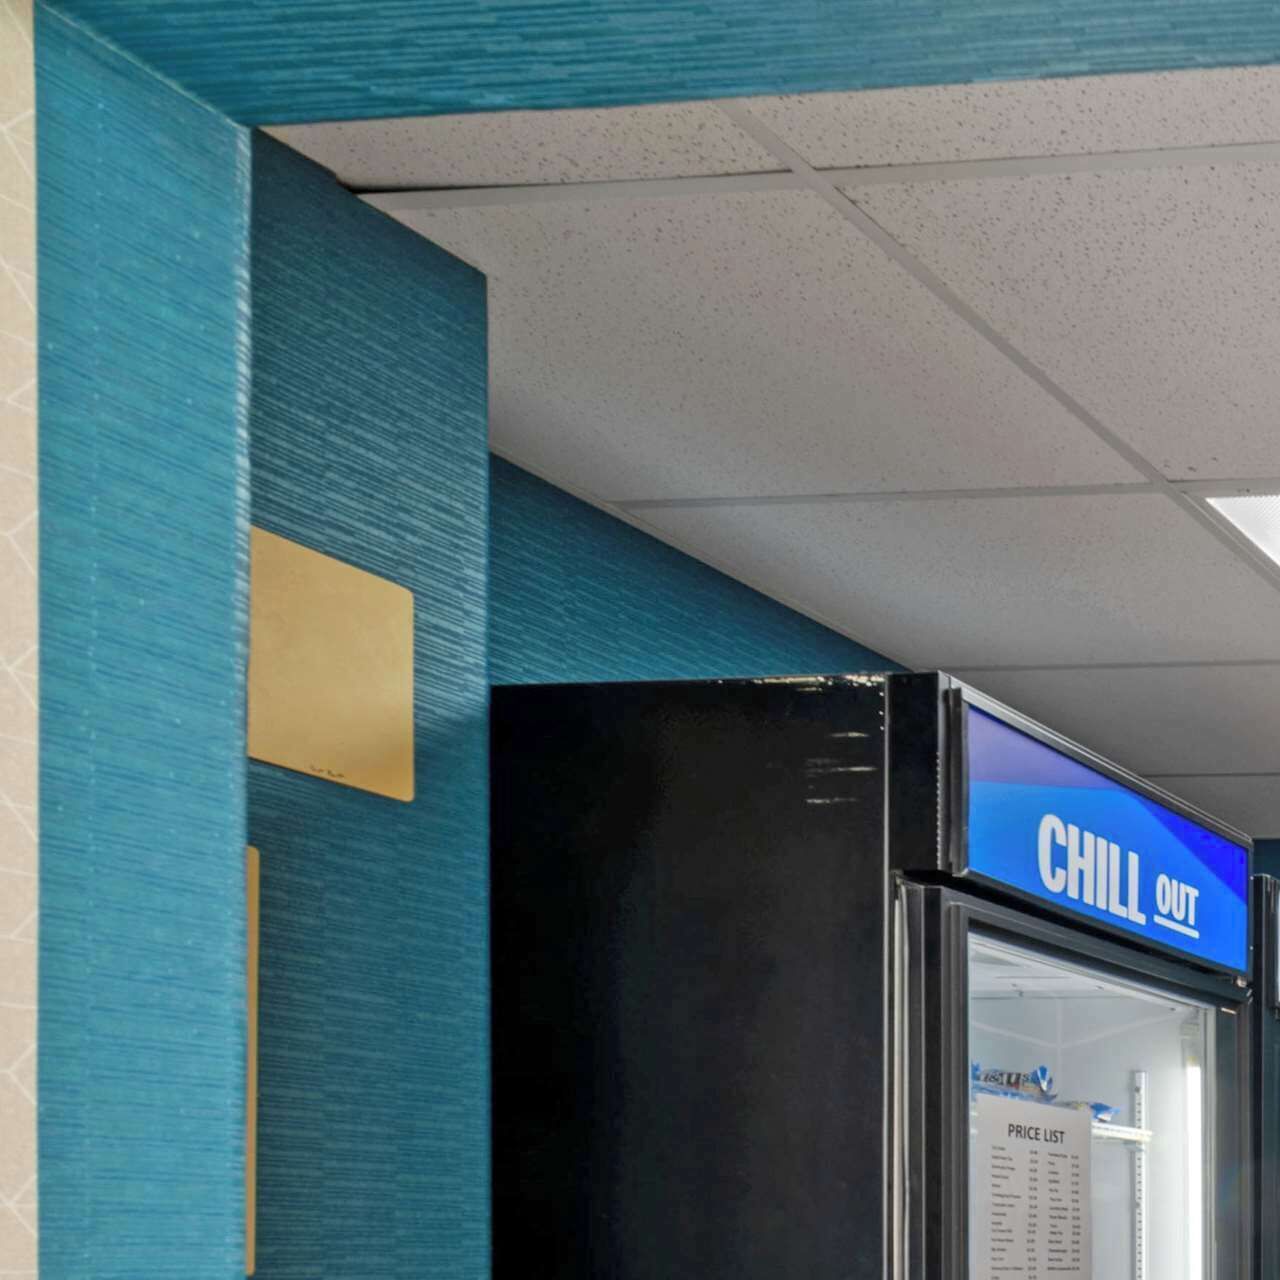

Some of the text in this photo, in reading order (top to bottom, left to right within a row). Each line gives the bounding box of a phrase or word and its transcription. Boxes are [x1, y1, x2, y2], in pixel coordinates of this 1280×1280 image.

[1038, 814, 1199, 938] CHILL OUT
[1008, 1123, 1064, 1144] PRICE LIST
